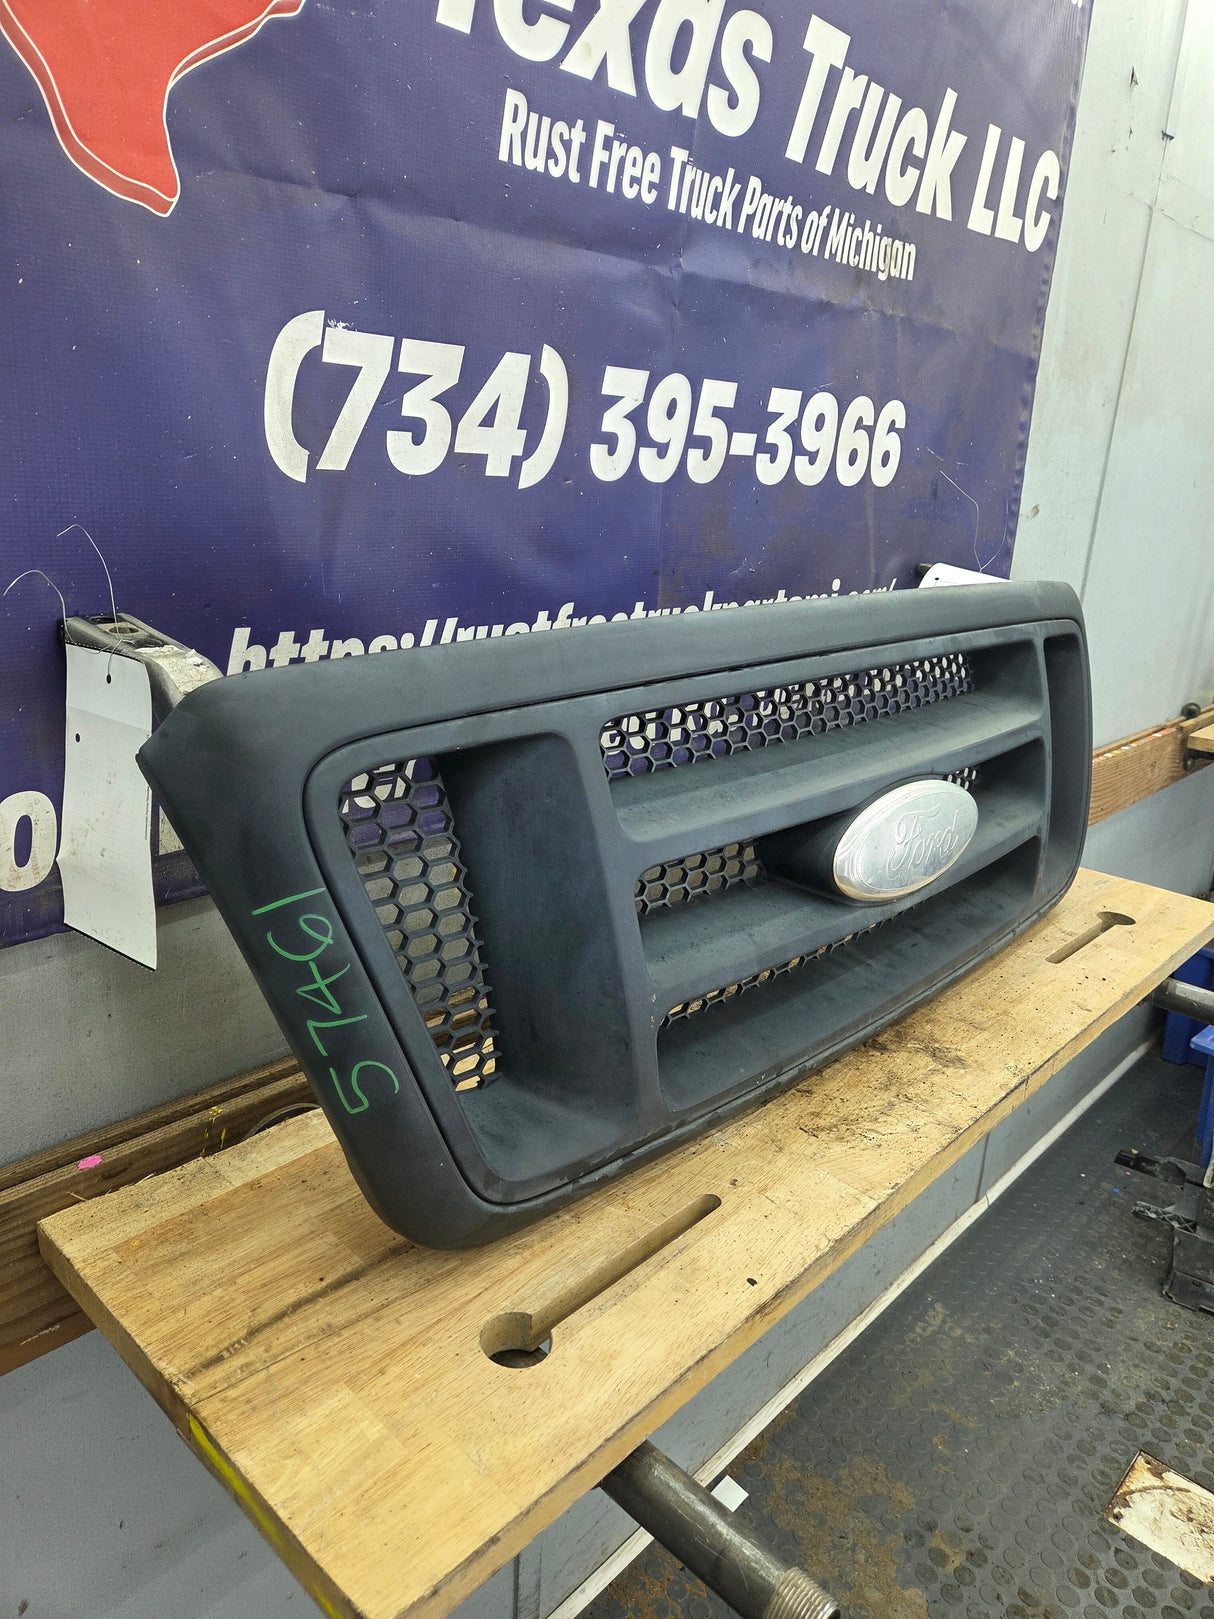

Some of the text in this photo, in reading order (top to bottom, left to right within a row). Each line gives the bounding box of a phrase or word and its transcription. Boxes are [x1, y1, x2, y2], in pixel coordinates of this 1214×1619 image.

[436, 0, 1061, 253] exas Truck LLC
[499, 88, 917, 281] Rust Free Truck Parts of Michigan
[264, 310, 907, 490] (734) 395-3966
[886, 803, 968, 881] Ford
